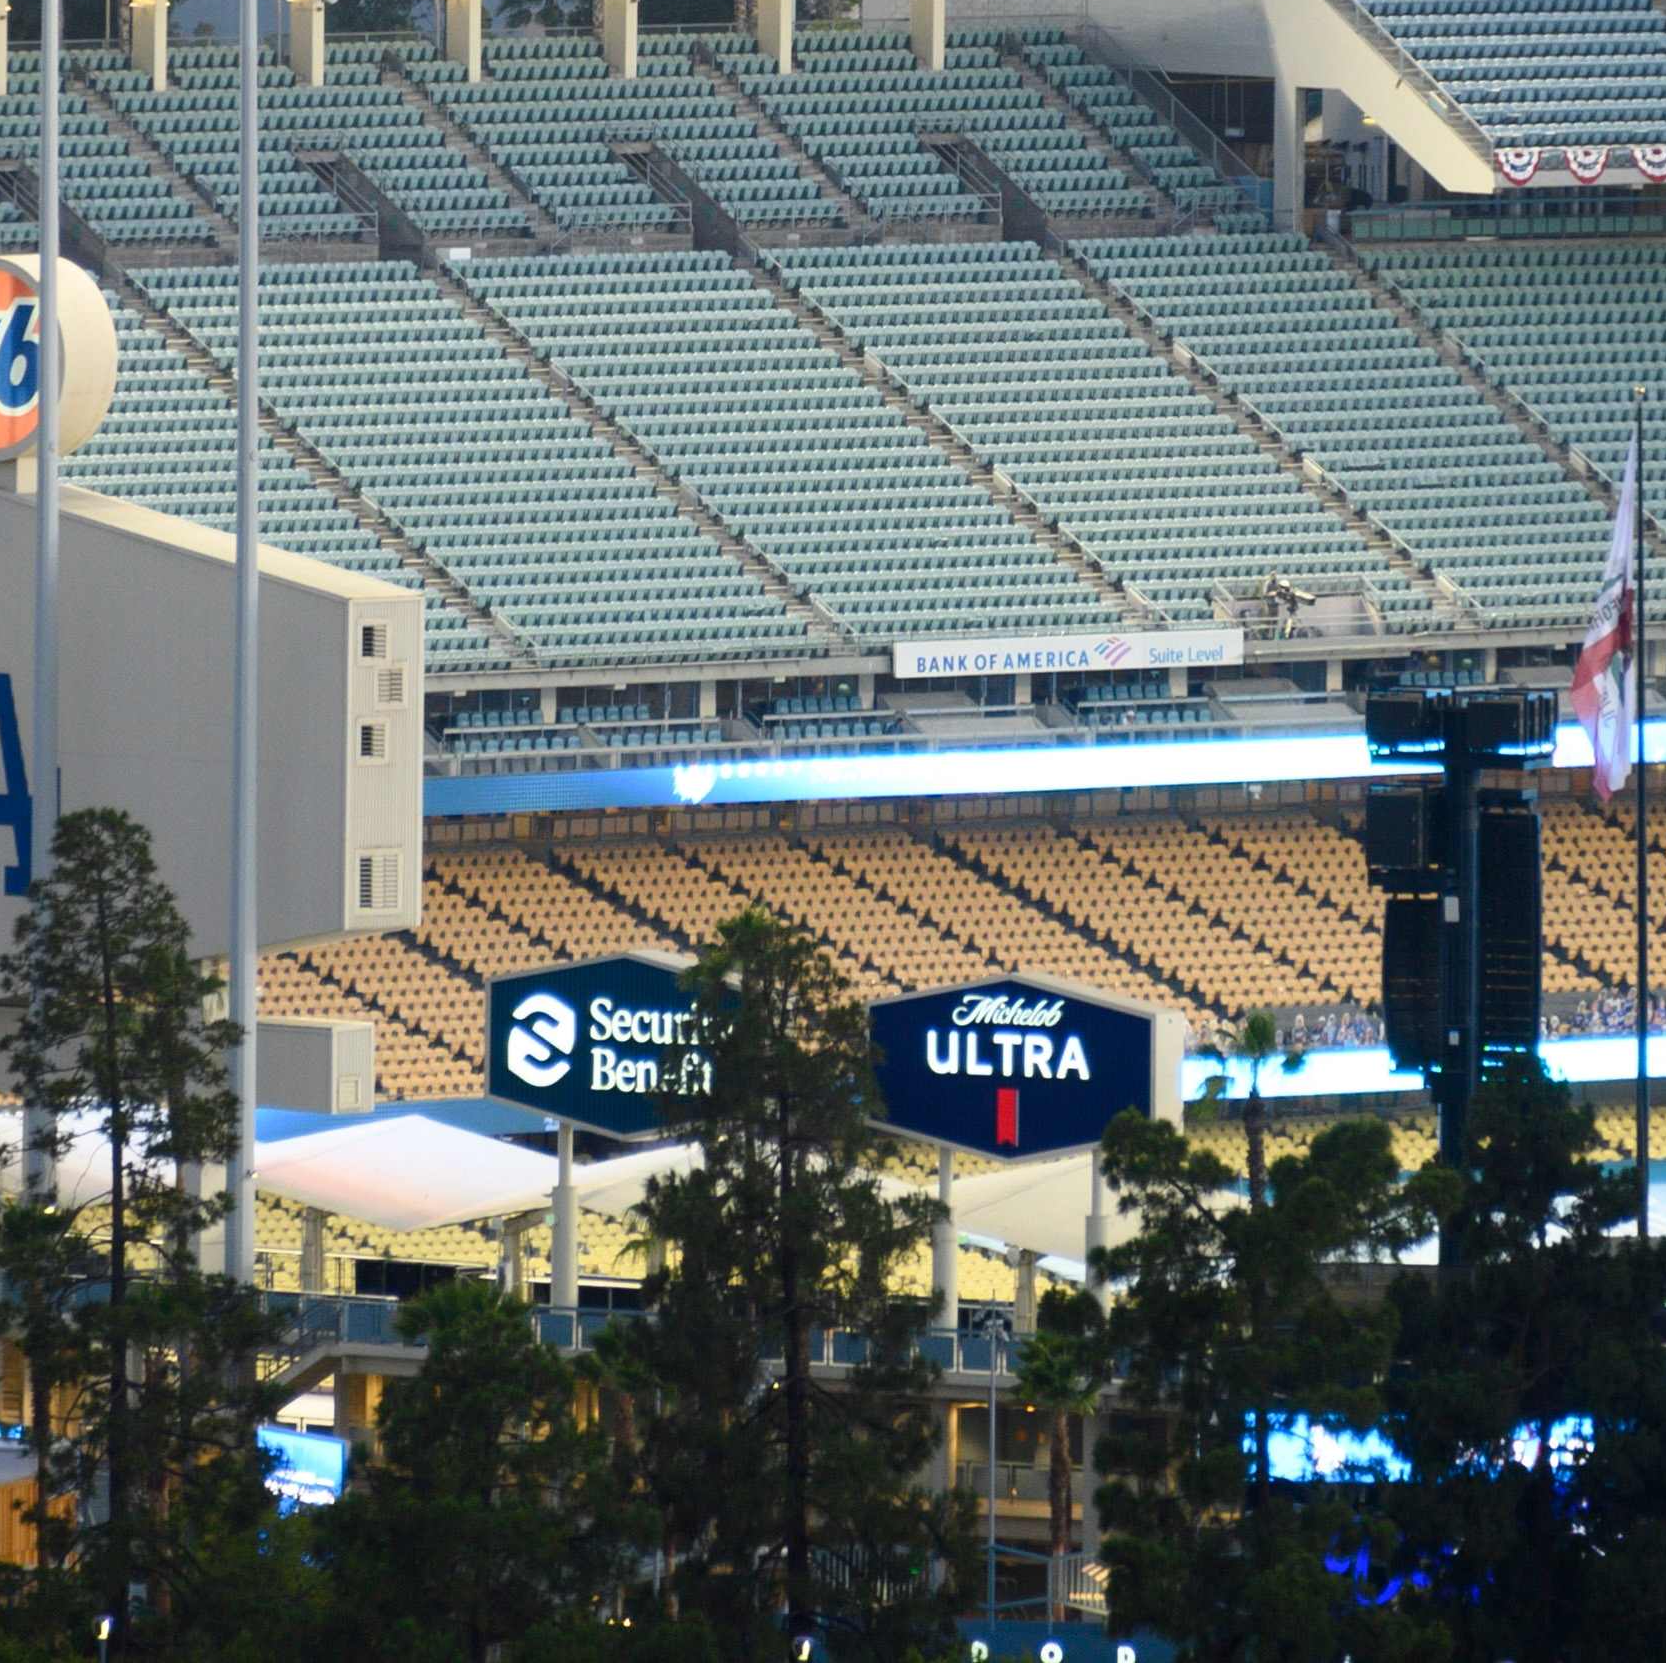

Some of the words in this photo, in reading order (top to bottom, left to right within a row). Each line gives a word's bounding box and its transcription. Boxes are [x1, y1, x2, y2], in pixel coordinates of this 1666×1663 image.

[916, 656, 968, 674] BANK
[974, 654, 999, 672] OF
[1003, 649, 1089, 670] AMERICA
[1148, 646, 1183, 664] Suite
[1188, 644, 1224, 663] Level
[952, 994, 1065, 1027] Michelob
[926, 1029, 1090, 1081] ULTRA
